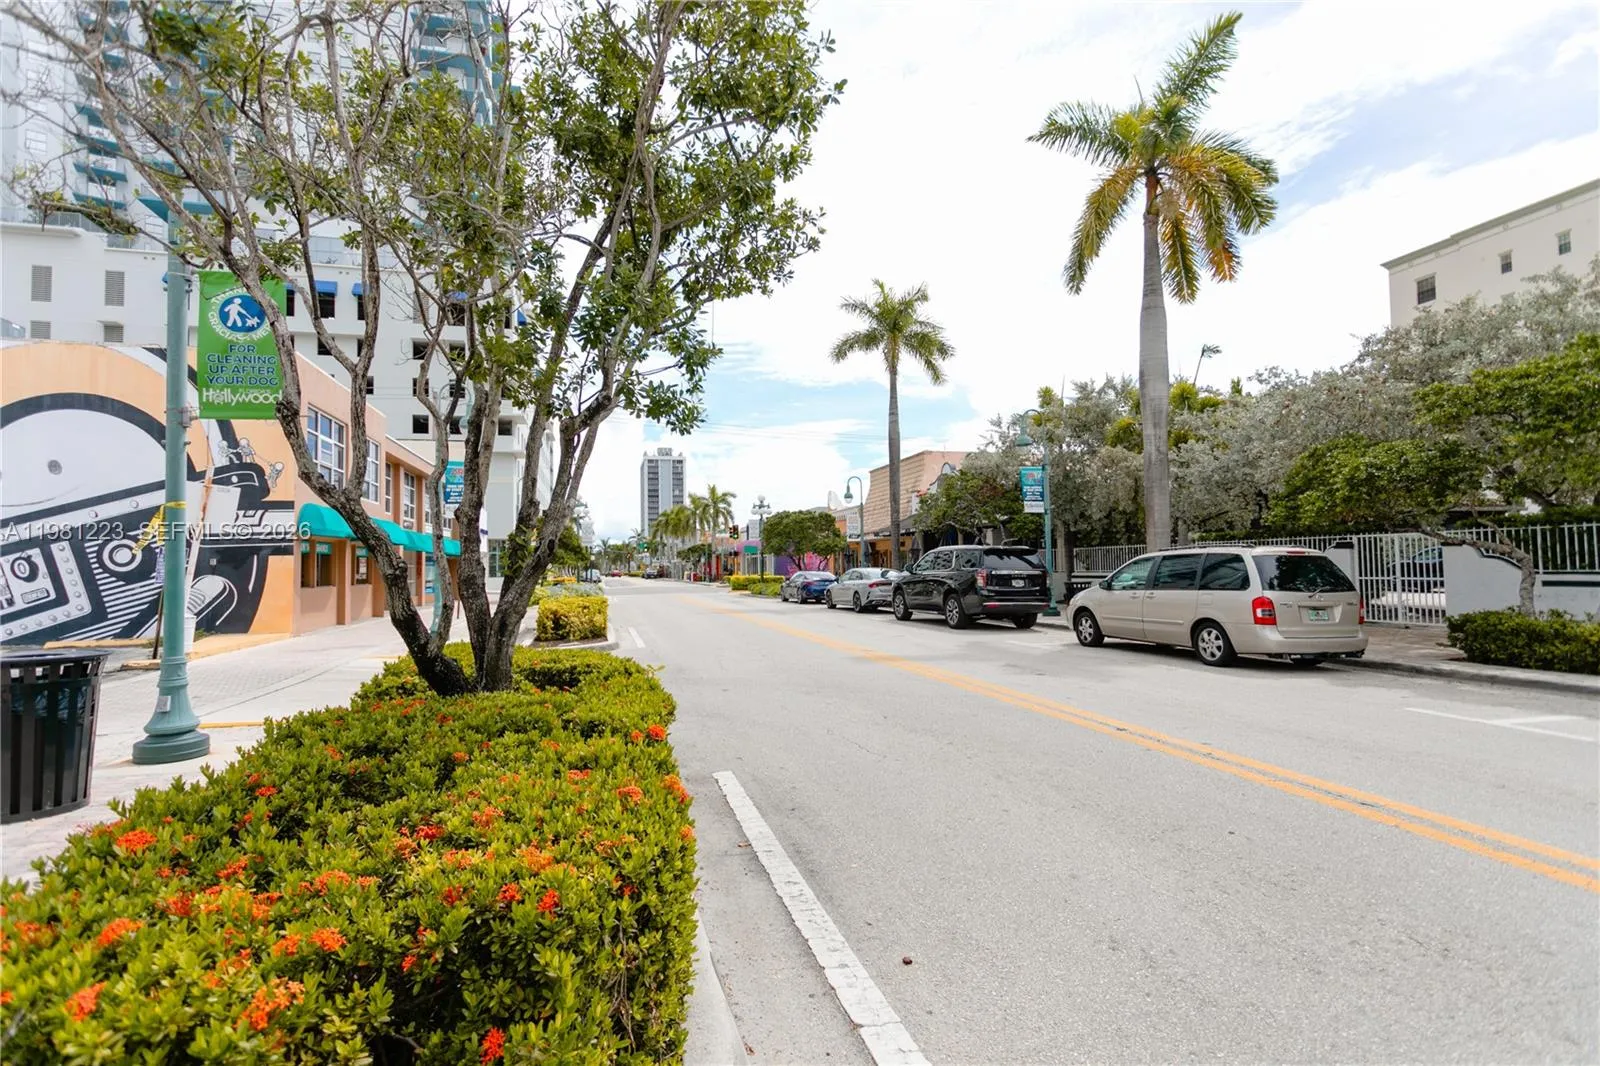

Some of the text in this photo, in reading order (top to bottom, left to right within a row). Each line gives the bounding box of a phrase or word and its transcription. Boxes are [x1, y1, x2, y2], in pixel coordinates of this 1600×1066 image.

[209, 286, 246, 304] THAN
[229, 344, 256, 353] FOR
[207, 354, 277, 365] CLEANING
[209, 365, 275, 375] UP AFTER
[206, 375, 278, 386] YOUR DOG
[202, 387, 282, 406] Hollywood
